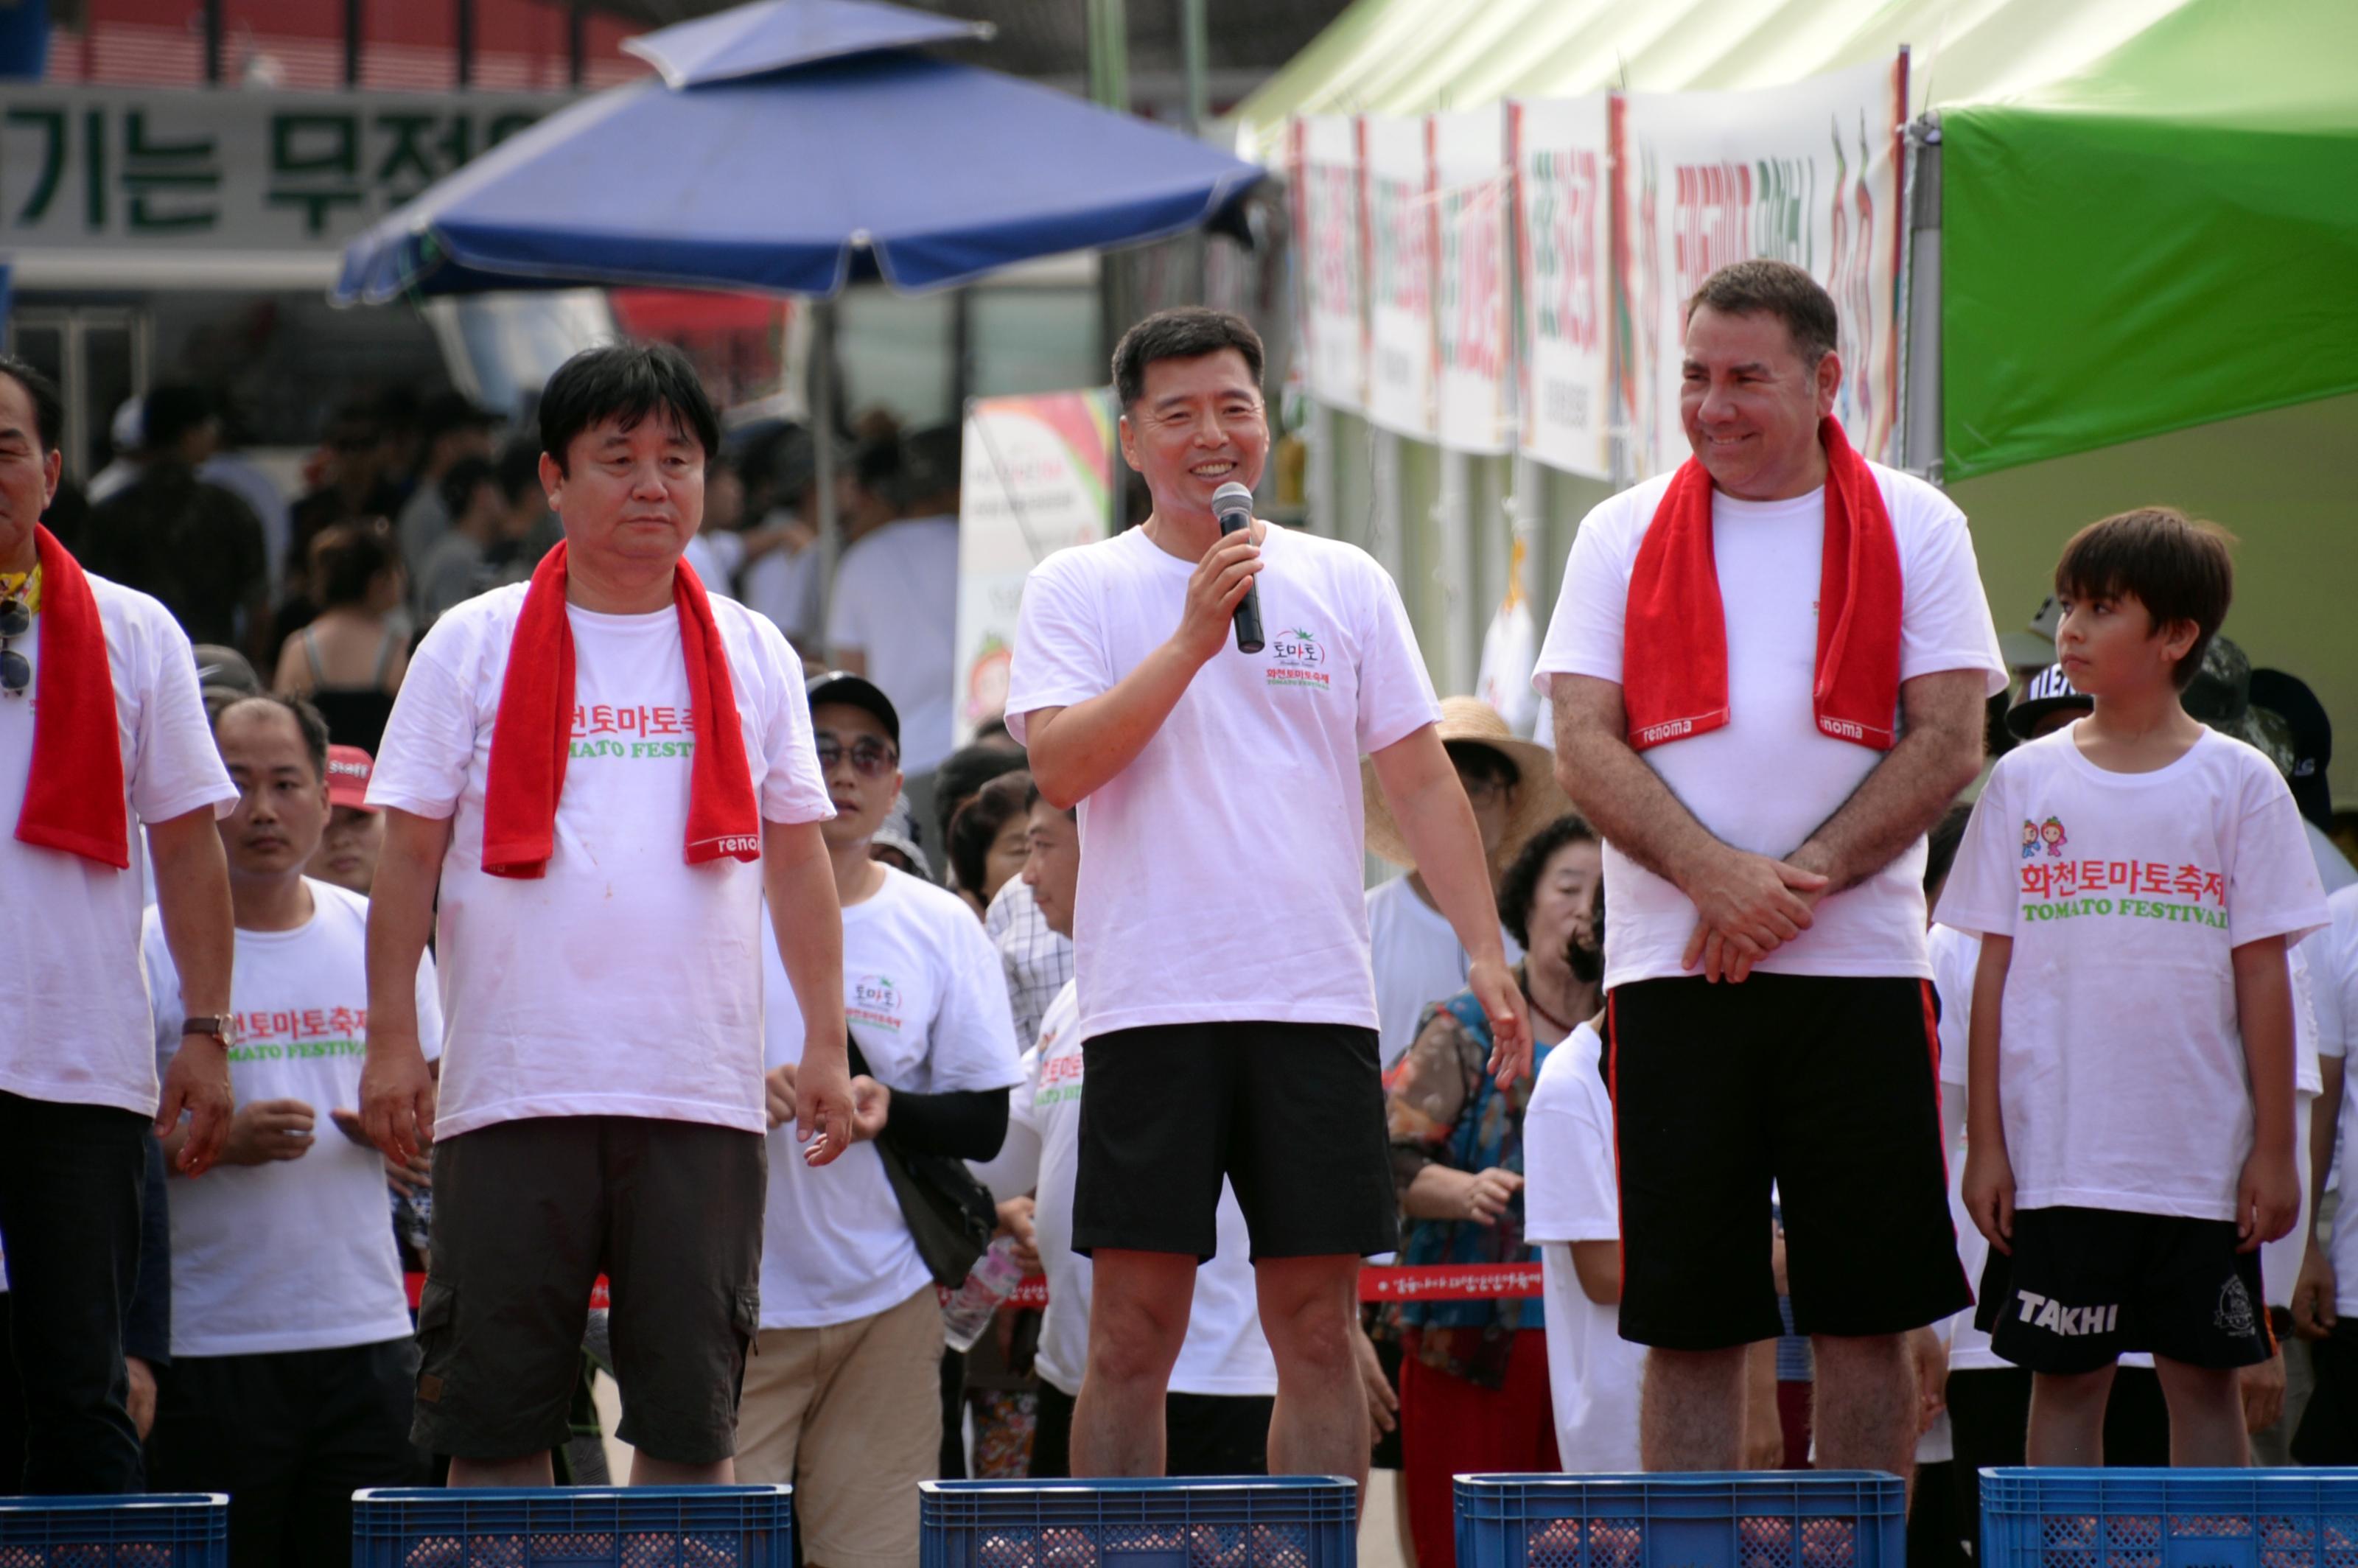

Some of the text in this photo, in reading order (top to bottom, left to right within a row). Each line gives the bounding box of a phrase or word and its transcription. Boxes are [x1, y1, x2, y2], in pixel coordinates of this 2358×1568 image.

[1273, 640, 1318, 661] 토마토
[1644, 720, 1693, 743] renoma
[718, 836, 760, 853] reno
[2023, 898, 2113, 921] TOMATO
[2017, 1289, 2119, 1336] TAKHI
